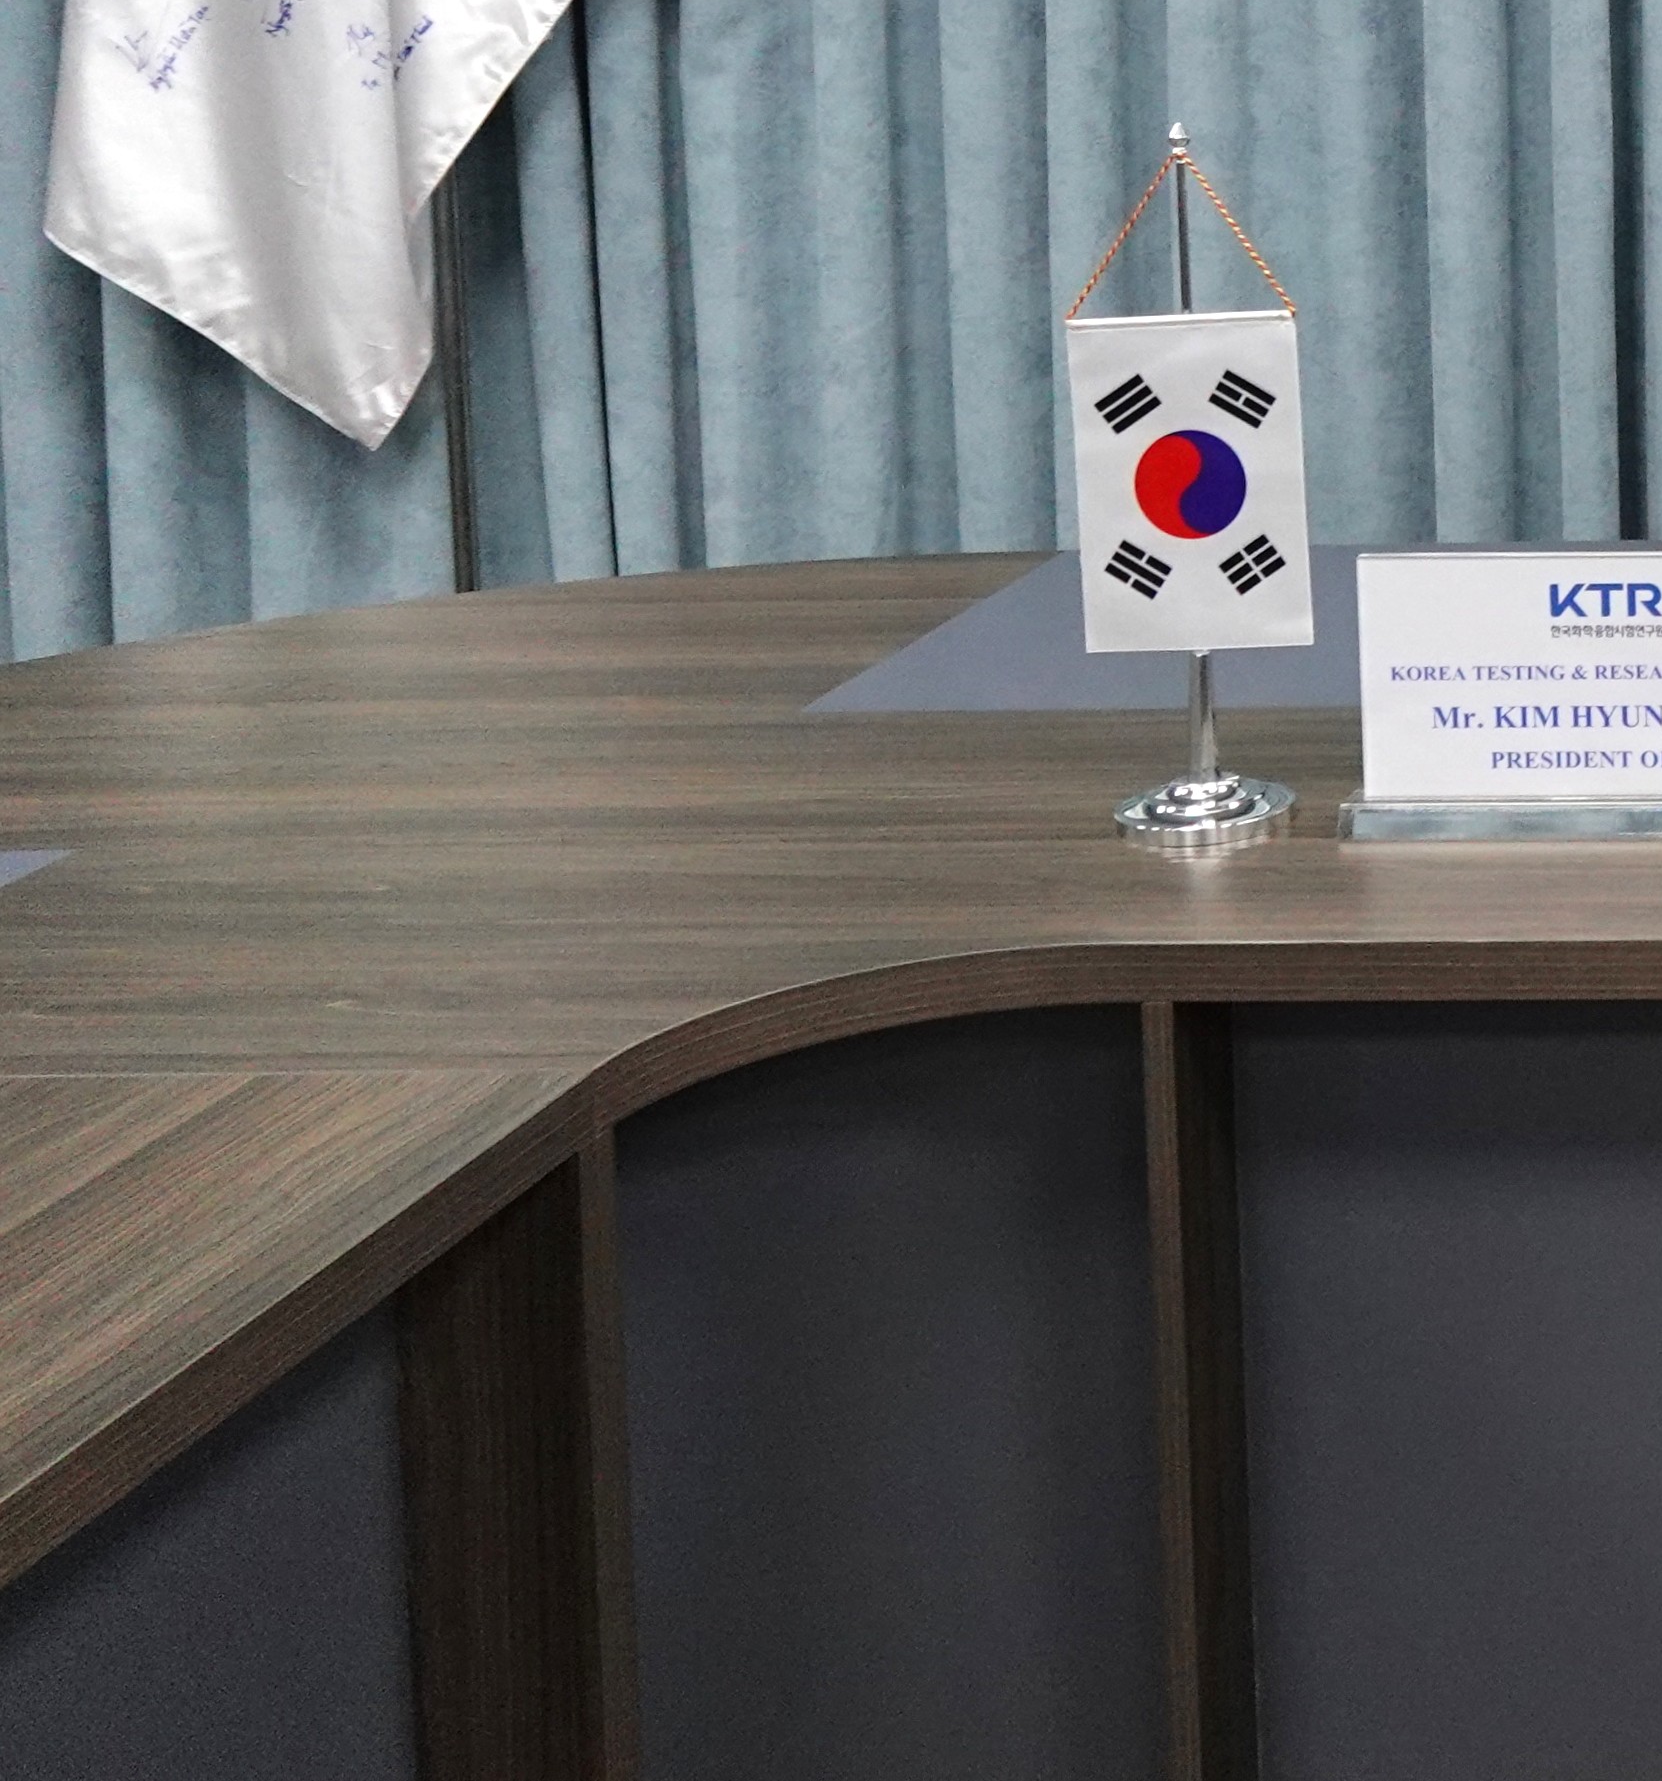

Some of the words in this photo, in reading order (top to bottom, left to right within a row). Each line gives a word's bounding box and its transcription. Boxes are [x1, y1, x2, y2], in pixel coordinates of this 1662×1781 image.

[1390, 665, 1466, 681] KOREA
[1471, 664, 1565, 681] TESTING
[1572, 664, 1590, 681] &
[1431, 706, 1485, 729] Mr.
[1494, 706, 1561, 728] KIM
[1491, 751, 1633, 769] PRESIDENT
